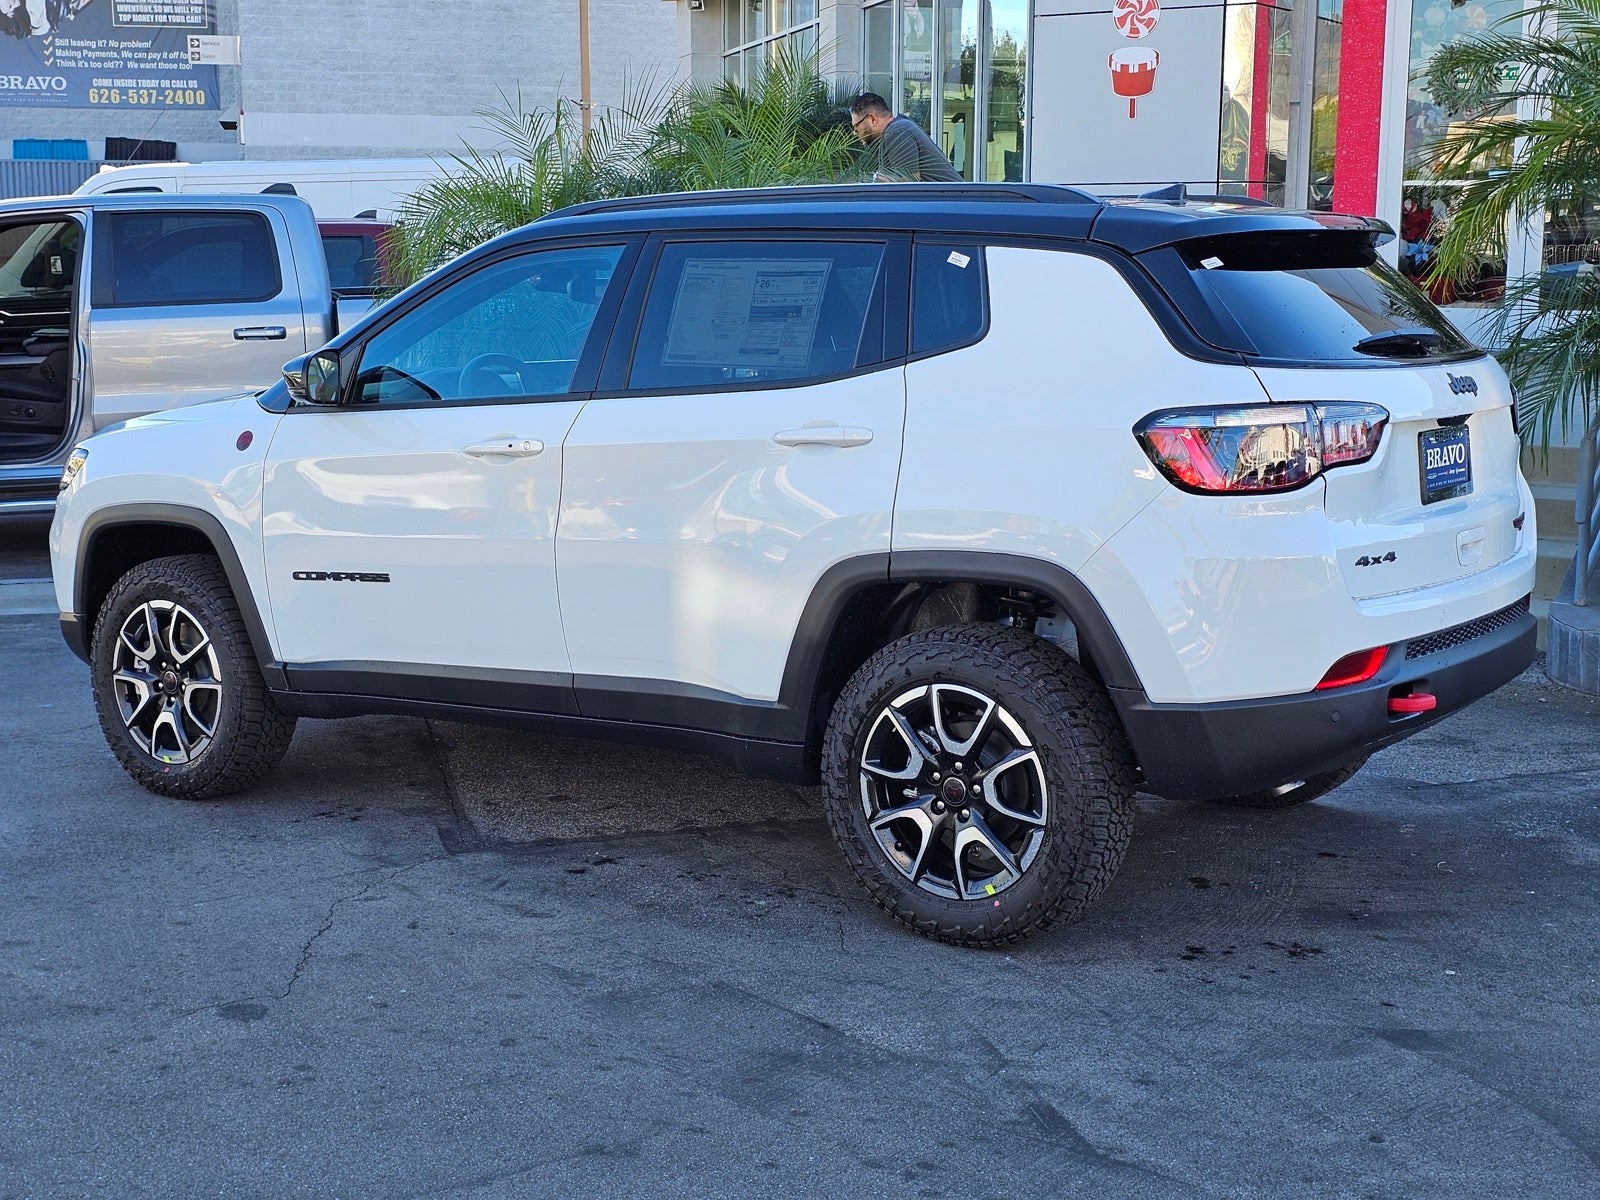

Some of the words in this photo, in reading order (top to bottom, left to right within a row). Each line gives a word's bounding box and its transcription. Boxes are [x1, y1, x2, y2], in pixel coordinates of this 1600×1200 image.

[55, 38, 70, 46] Still
[70, 39, 96, 48] leasing
[120, 40, 151, 49] problem!
[56, 49, 81, 58] Making
[83, 50, 120, 59] Payments,
[0, 75, 67, 90] BRAVO
[114, 79, 136, 87] INSIDE
[138, 79, 159, 88] TODAY
[89, 88, 205, 105] 626-537-2400
[760, 280, 770, 288] 26
[1446, 372, 1478, 397] Jeep
[1427, 443, 1465, 470] BRAVO
[1355, 551, 1397, 567] 4x4
[292, 572, 390, 582] COMPASS
